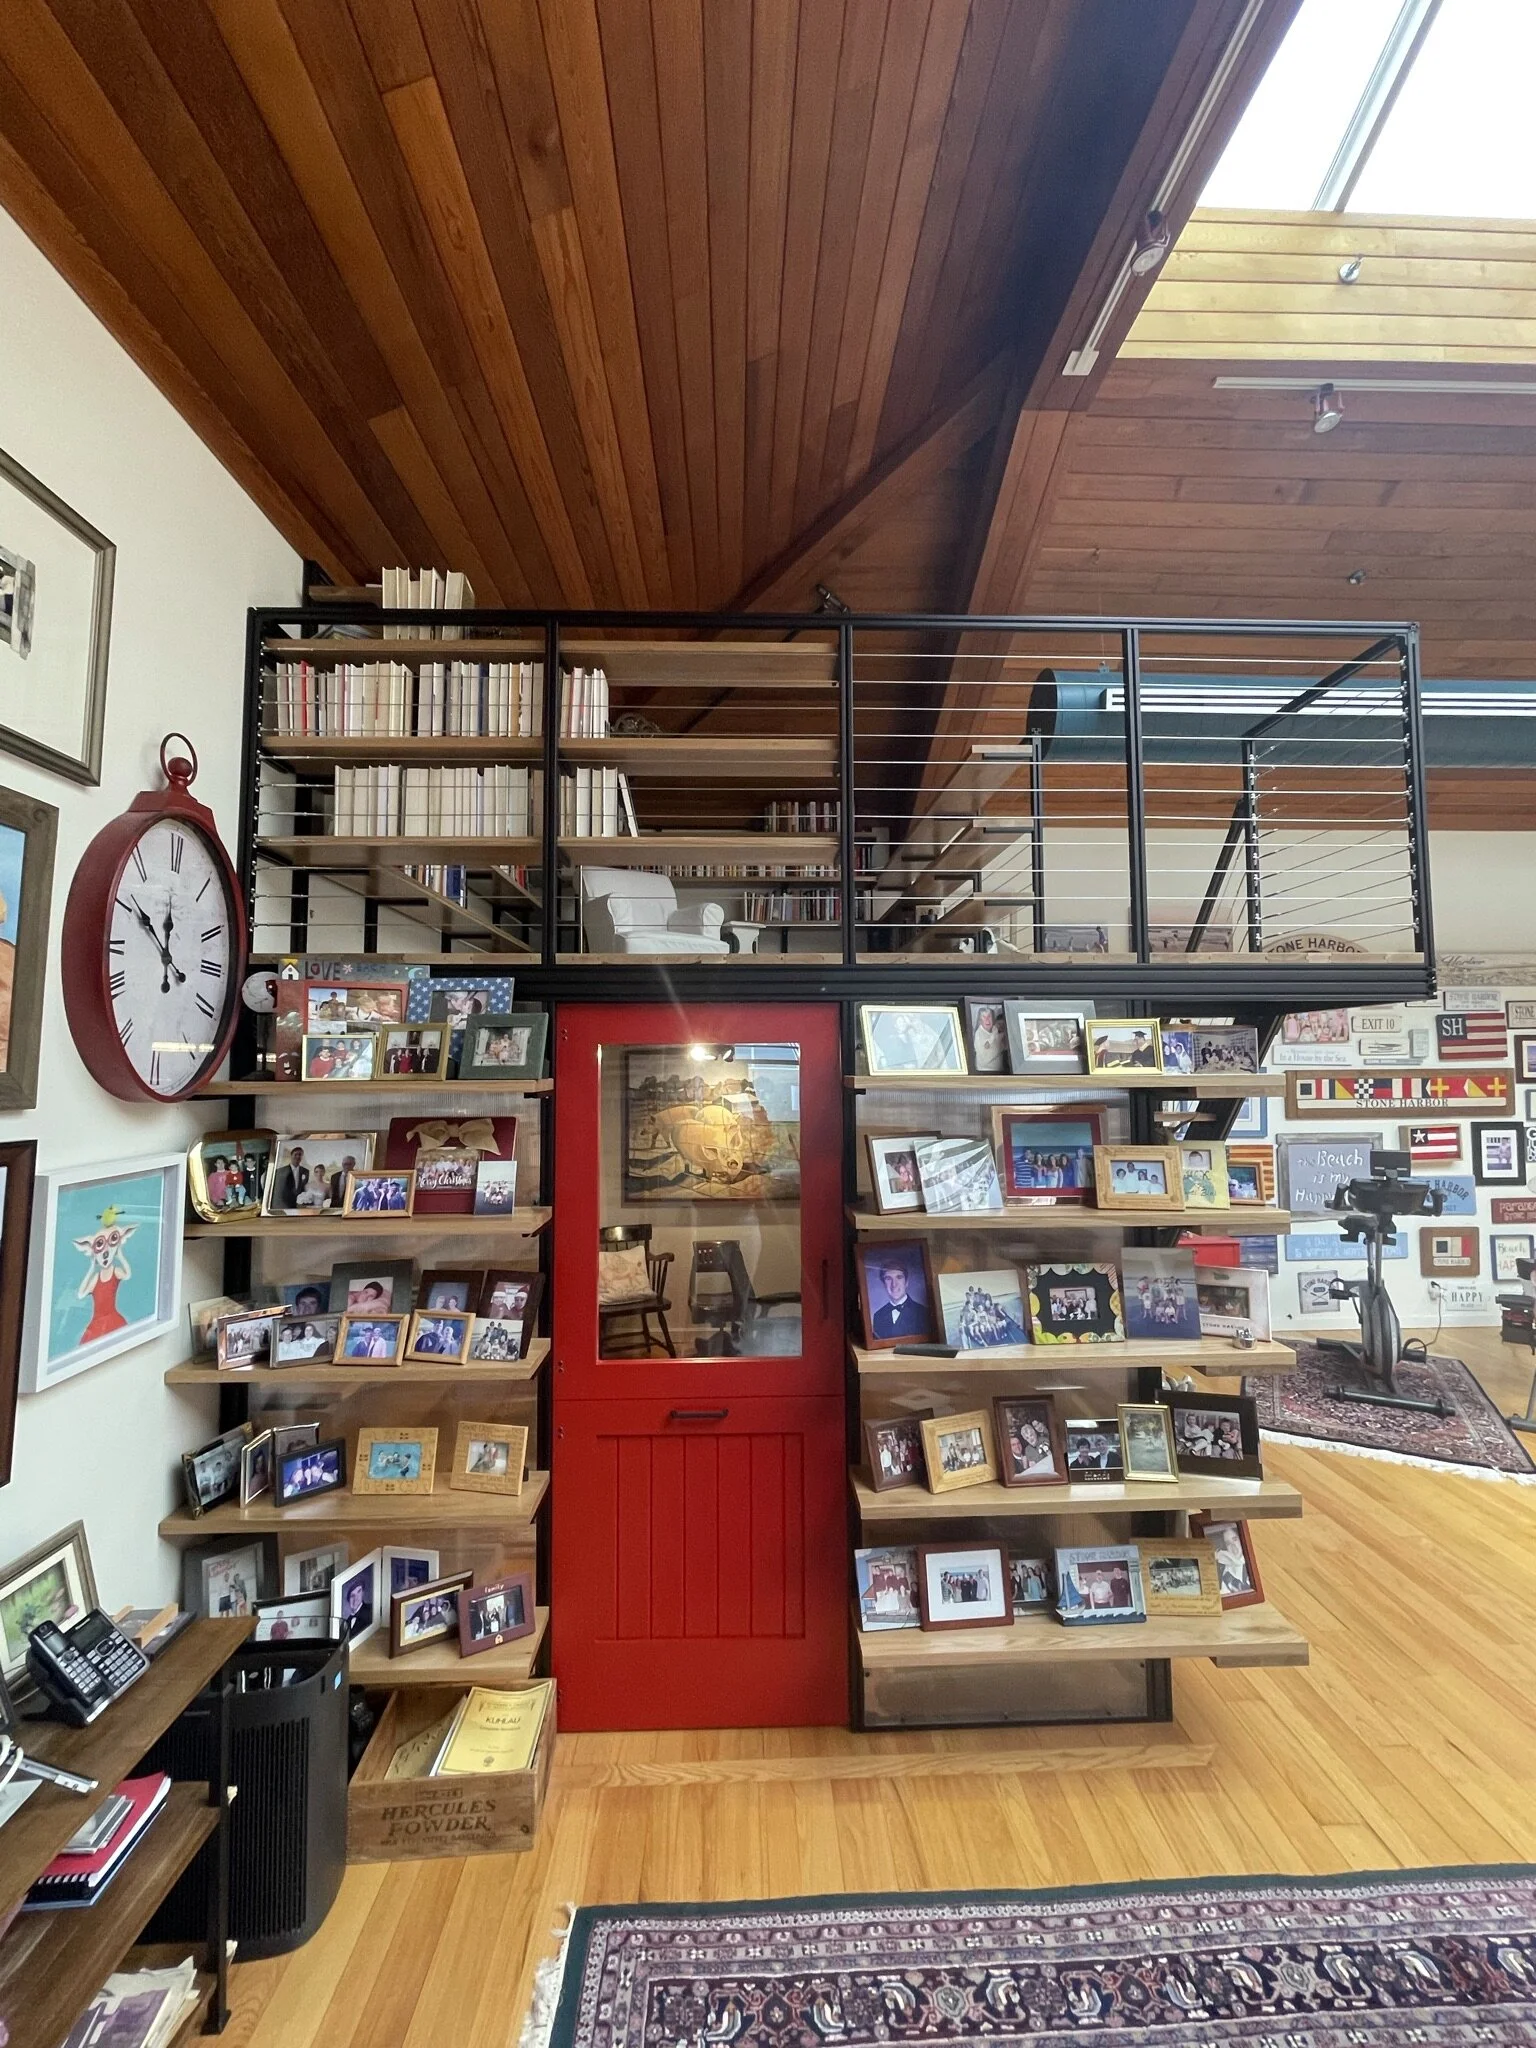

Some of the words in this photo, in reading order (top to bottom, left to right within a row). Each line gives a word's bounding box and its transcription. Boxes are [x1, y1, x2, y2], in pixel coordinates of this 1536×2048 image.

[1268, 939, 1304, 953] ONE
[1307, 937, 1361, 953] HARBO
[304, 961, 341, 981] LOVE
[1361, 1018, 1383, 1030] EXIT
[1386, 1018, 1395, 1030] 10
[1441, 1017, 1464, 1036] SH
[1356, 1098, 1396, 1108] STONE
[1400, 1098, 1449, 1108] HARBOR
[1317, 1149, 1363, 1167] Beach
[1313, 1172, 1325, 1184] is
[1330, 1173, 1349, 1187] my
[1434, 1179, 1470, 1200] HARBOR
[1451, 1292, 1483, 1302] HAPPY
[484, 1583, 505, 1594] family
[381, 1799, 497, 1821] HERCULES
[388, 1815, 491, 1837] POWDER
